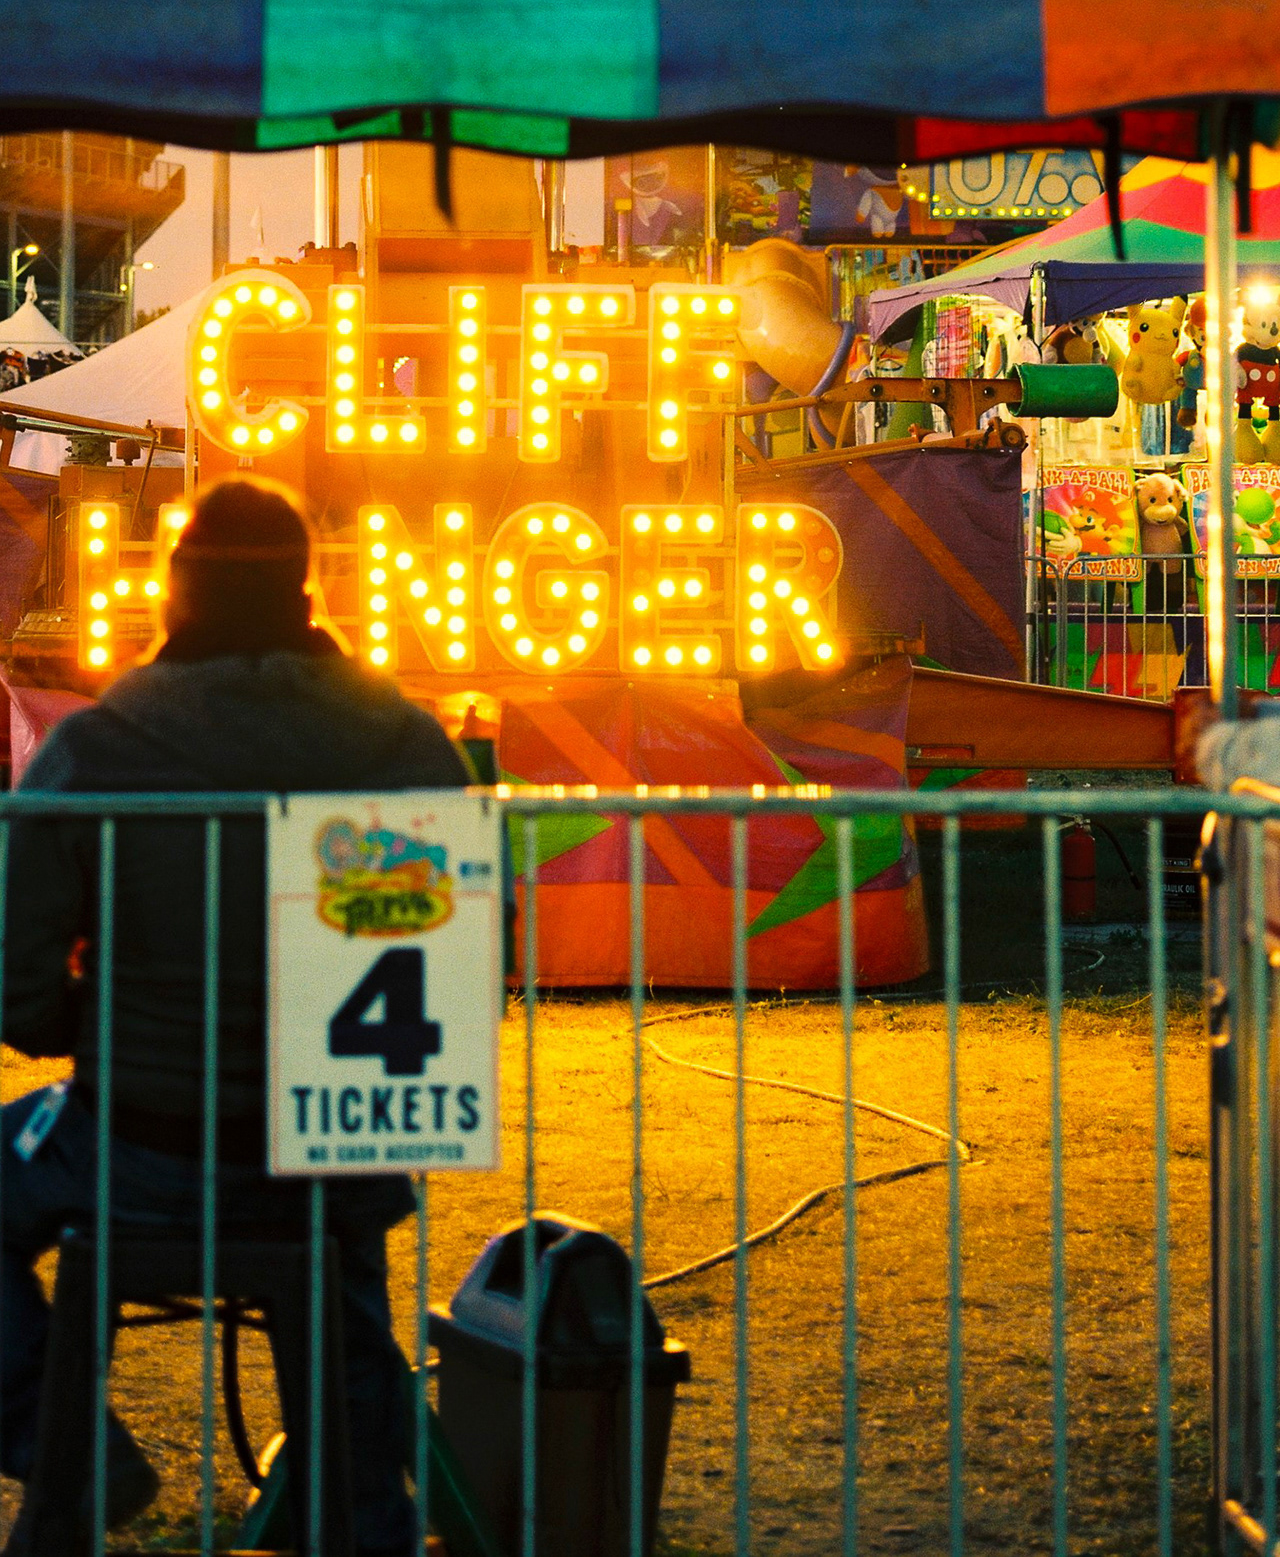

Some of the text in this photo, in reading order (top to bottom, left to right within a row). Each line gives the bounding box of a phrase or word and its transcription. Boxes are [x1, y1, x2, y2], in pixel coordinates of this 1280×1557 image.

[189, 270, 741, 462] CLIFF
[1041, 469, 1131, 499] NK-A-BALL
[79, 501, 843, 675] HNGER
[328, 946, 443, 1077] 4
[290, 1084, 481, 1134] TICKETS
